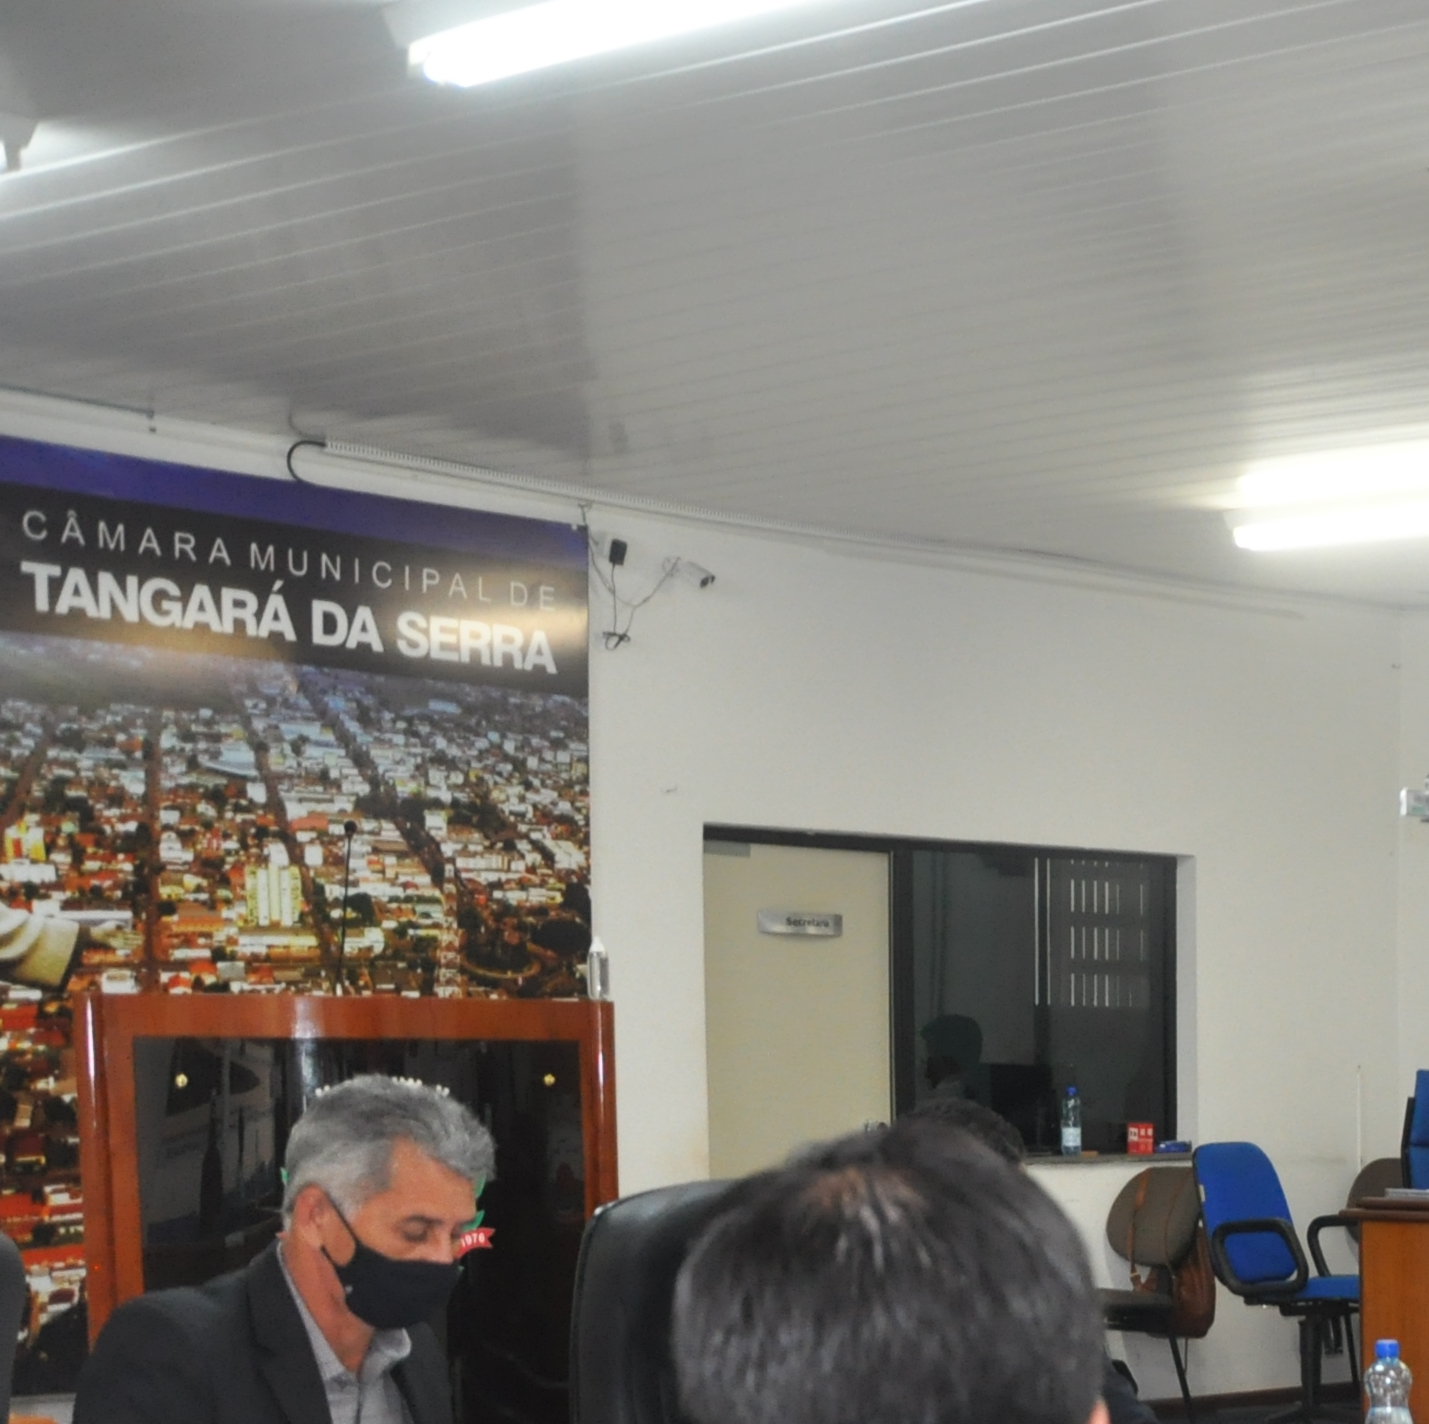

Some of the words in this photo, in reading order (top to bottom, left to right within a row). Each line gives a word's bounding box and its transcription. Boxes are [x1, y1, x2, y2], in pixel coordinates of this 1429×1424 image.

[22, 511, 231, 566] CÂMARA
[250, 542, 492, 602] MUNICIPAL
[508, 582, 557, 612] DE
[21, 560, 297, 642] TANGARÁ
[312, 599, 383, 652] DA
[397, 611, 557, 674] SERRA
